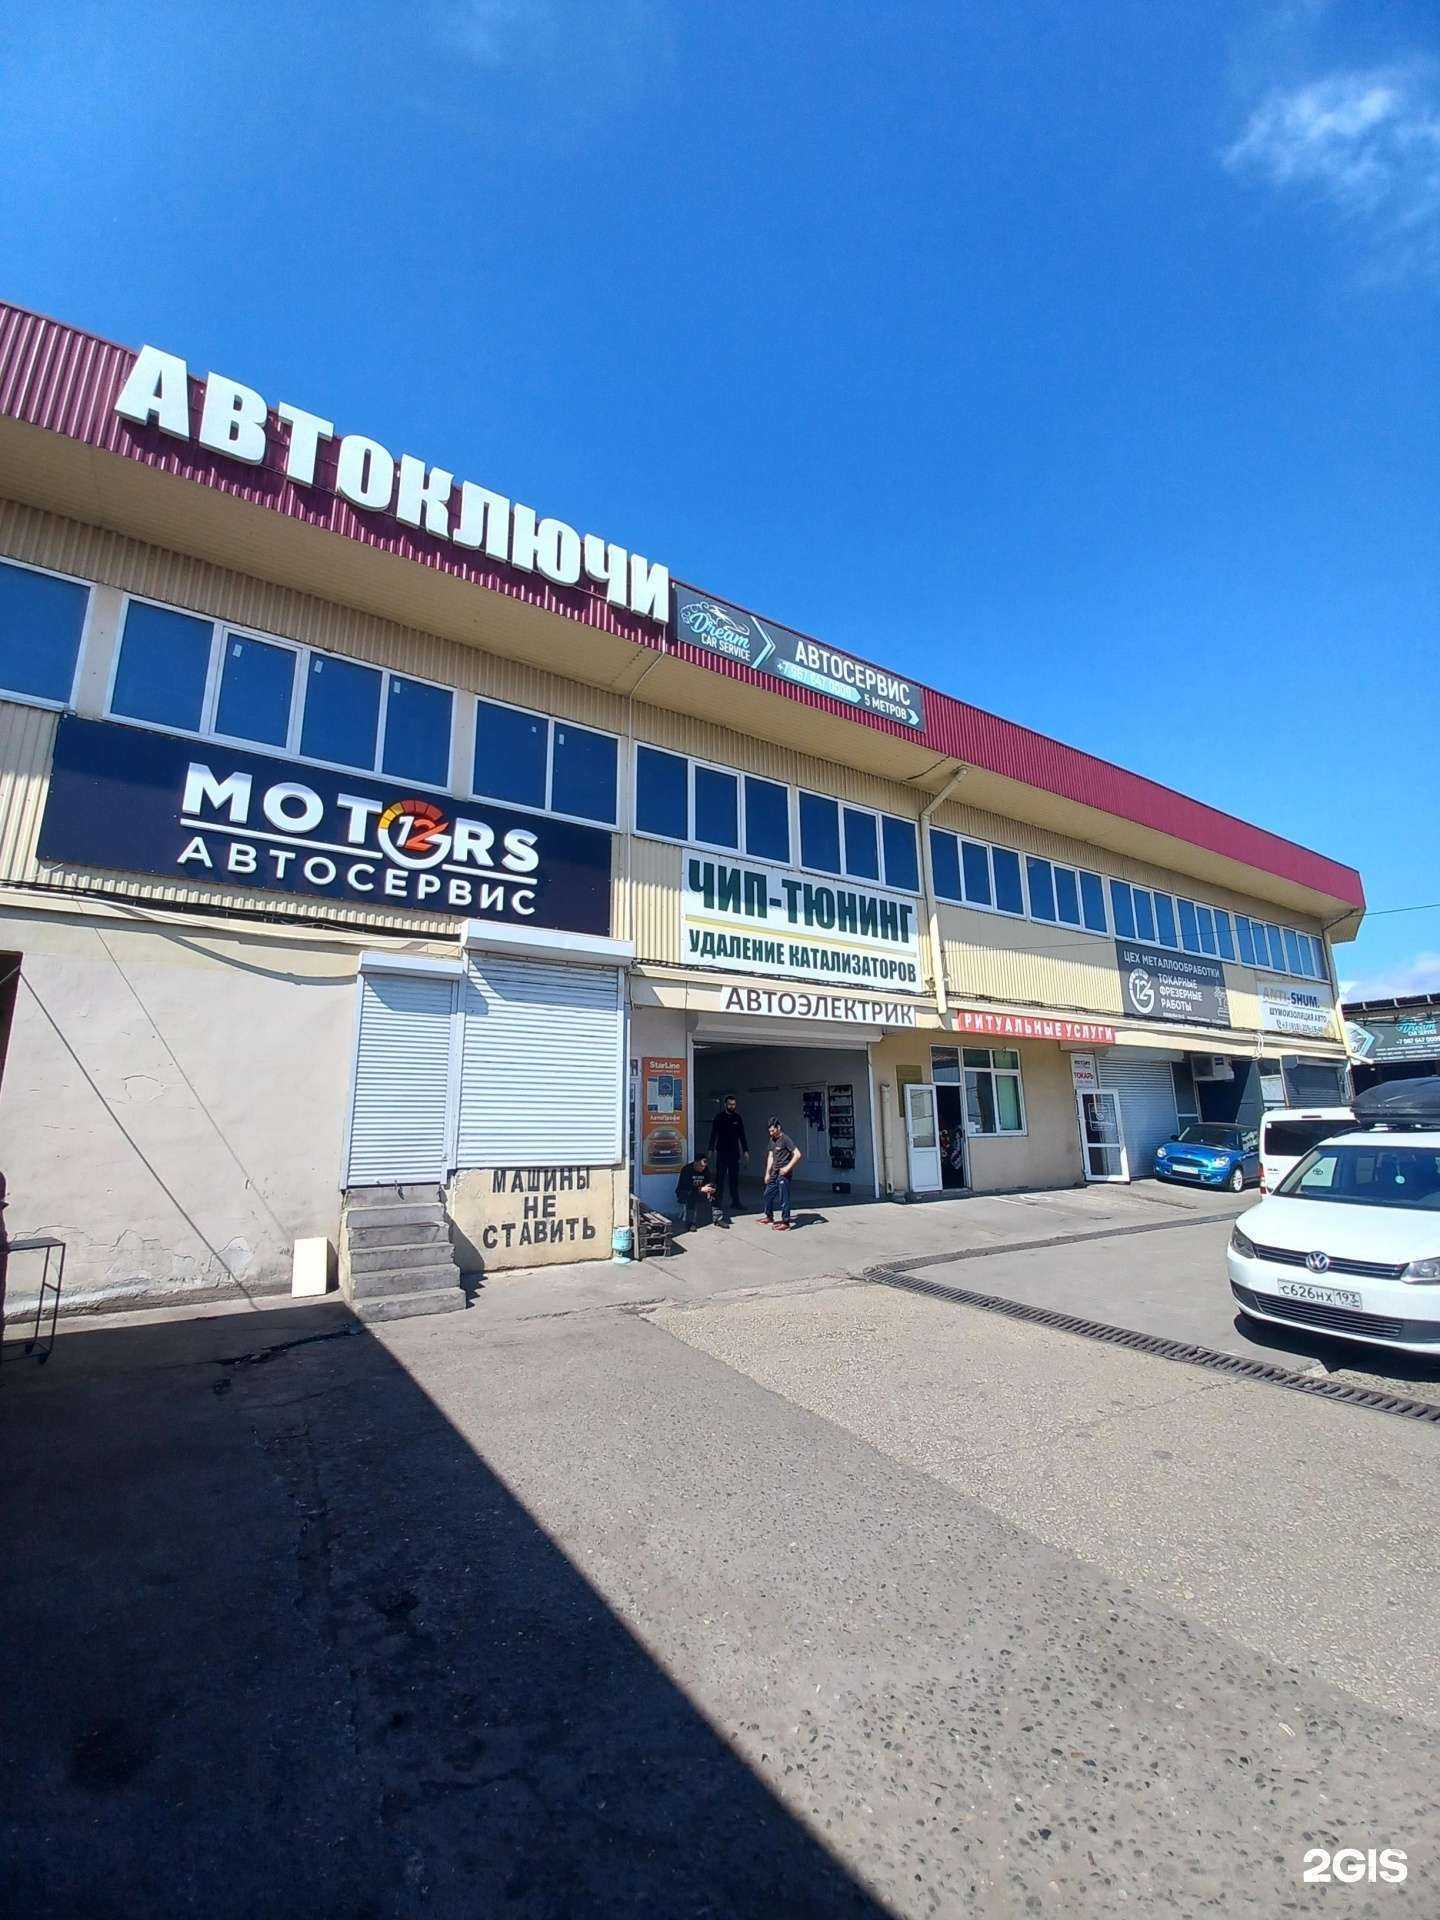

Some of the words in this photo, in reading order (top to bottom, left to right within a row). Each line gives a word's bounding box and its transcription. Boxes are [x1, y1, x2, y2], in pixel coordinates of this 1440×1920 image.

[114, 345, 669, 625] АВТОКЛЮЧИ
[689, 613, 750, 648] Dream
[701, 634, 717, 648] CAR
[719, 640, 751, 661] SERVICE
[795, 641, 910, 705] АВТОСЕРВИС
[864, 694, 871, 707] 5
[872, 698, 907, 720] МЕТРОВ
[177, 836, 537, 915] АВТОСЕРВИС
[688, 859, 913, 943] ЧИП-ТЮНИНГ
[689, 929, 785, 965] УДАЛЕНИЕ
[789, 945, 917, 982] КАТАЛИЗАТОРОВ
[1123, 950, 1141, 964] ЦЕХ
[1142, 956, 1220, 978] МЕТАЛЛООБРАБОТКИ
[1158, 973, 1198, 989] ТОКАРНЫЕ
[1159, 986, 1203, 1001] ФРЕЗЕРНЫЕ
[725, 987, 914, 1026] АВТОЭЛЕКТРИК
[1160, 998, 1192, 1012] РАБОТЫ
[964, 1013, 1062, 1036] РИТУАЛЬНЫЕ
[1065, 1024, 1113, 1041] УСЛУГИ
[492, 1167, 590, 1193] МАШИНЫ
[524, 1195, 557, 1219] НЕ
[482, 1217, 596, 1249] СТАВИТЬ
